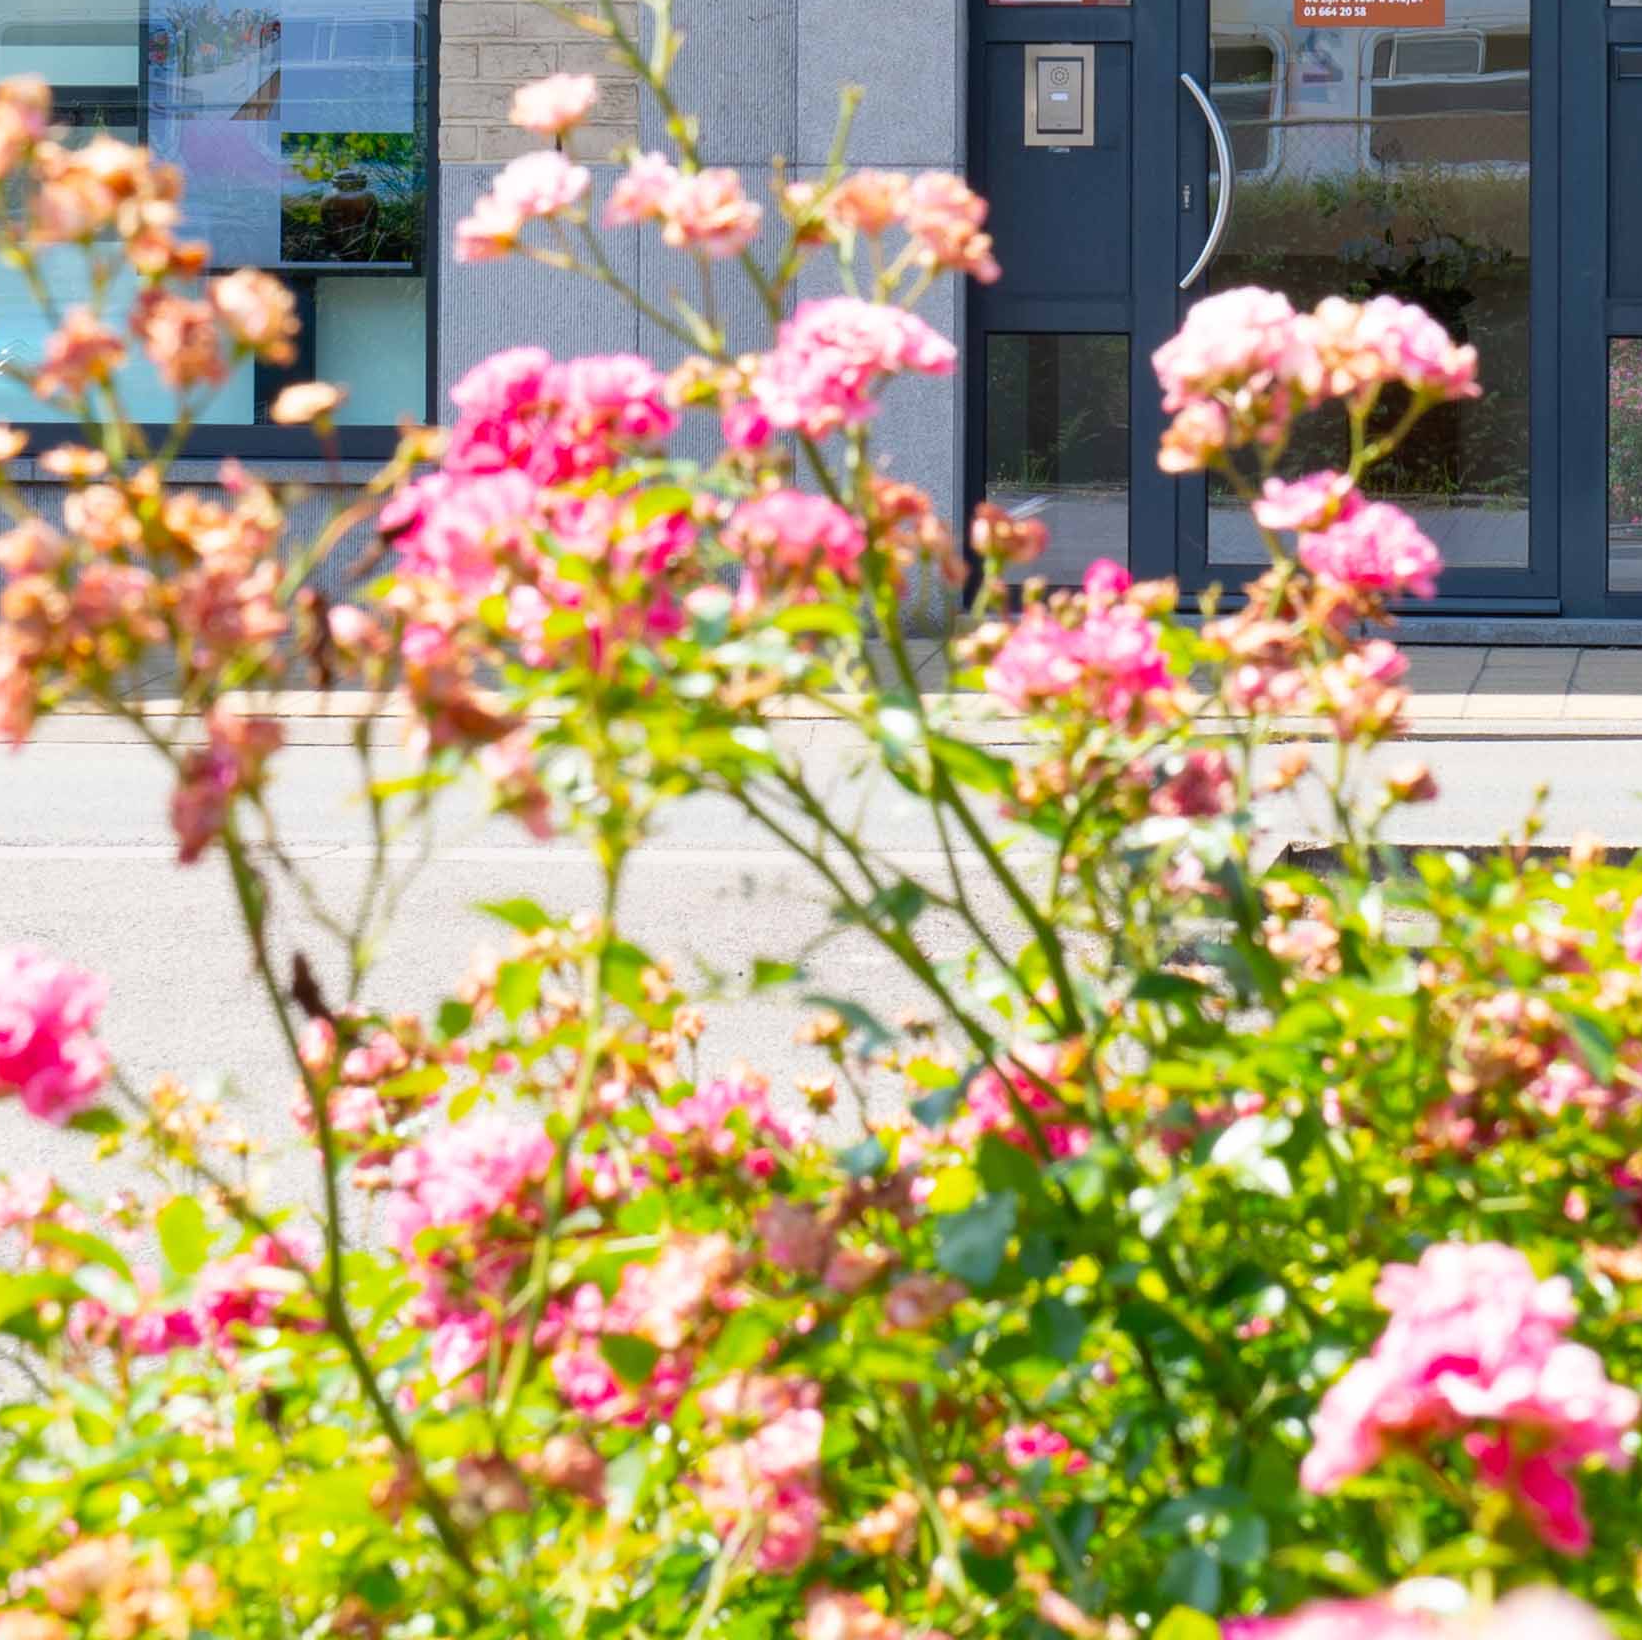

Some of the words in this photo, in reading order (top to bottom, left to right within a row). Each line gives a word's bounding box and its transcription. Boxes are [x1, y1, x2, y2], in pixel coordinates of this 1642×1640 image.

[1303, 6, 1316, 17] 03
[1318, 6, 1337, 17] 664
[1339, 6, 1352, 17] 20
[1354, 6, 1367, 17] 58
